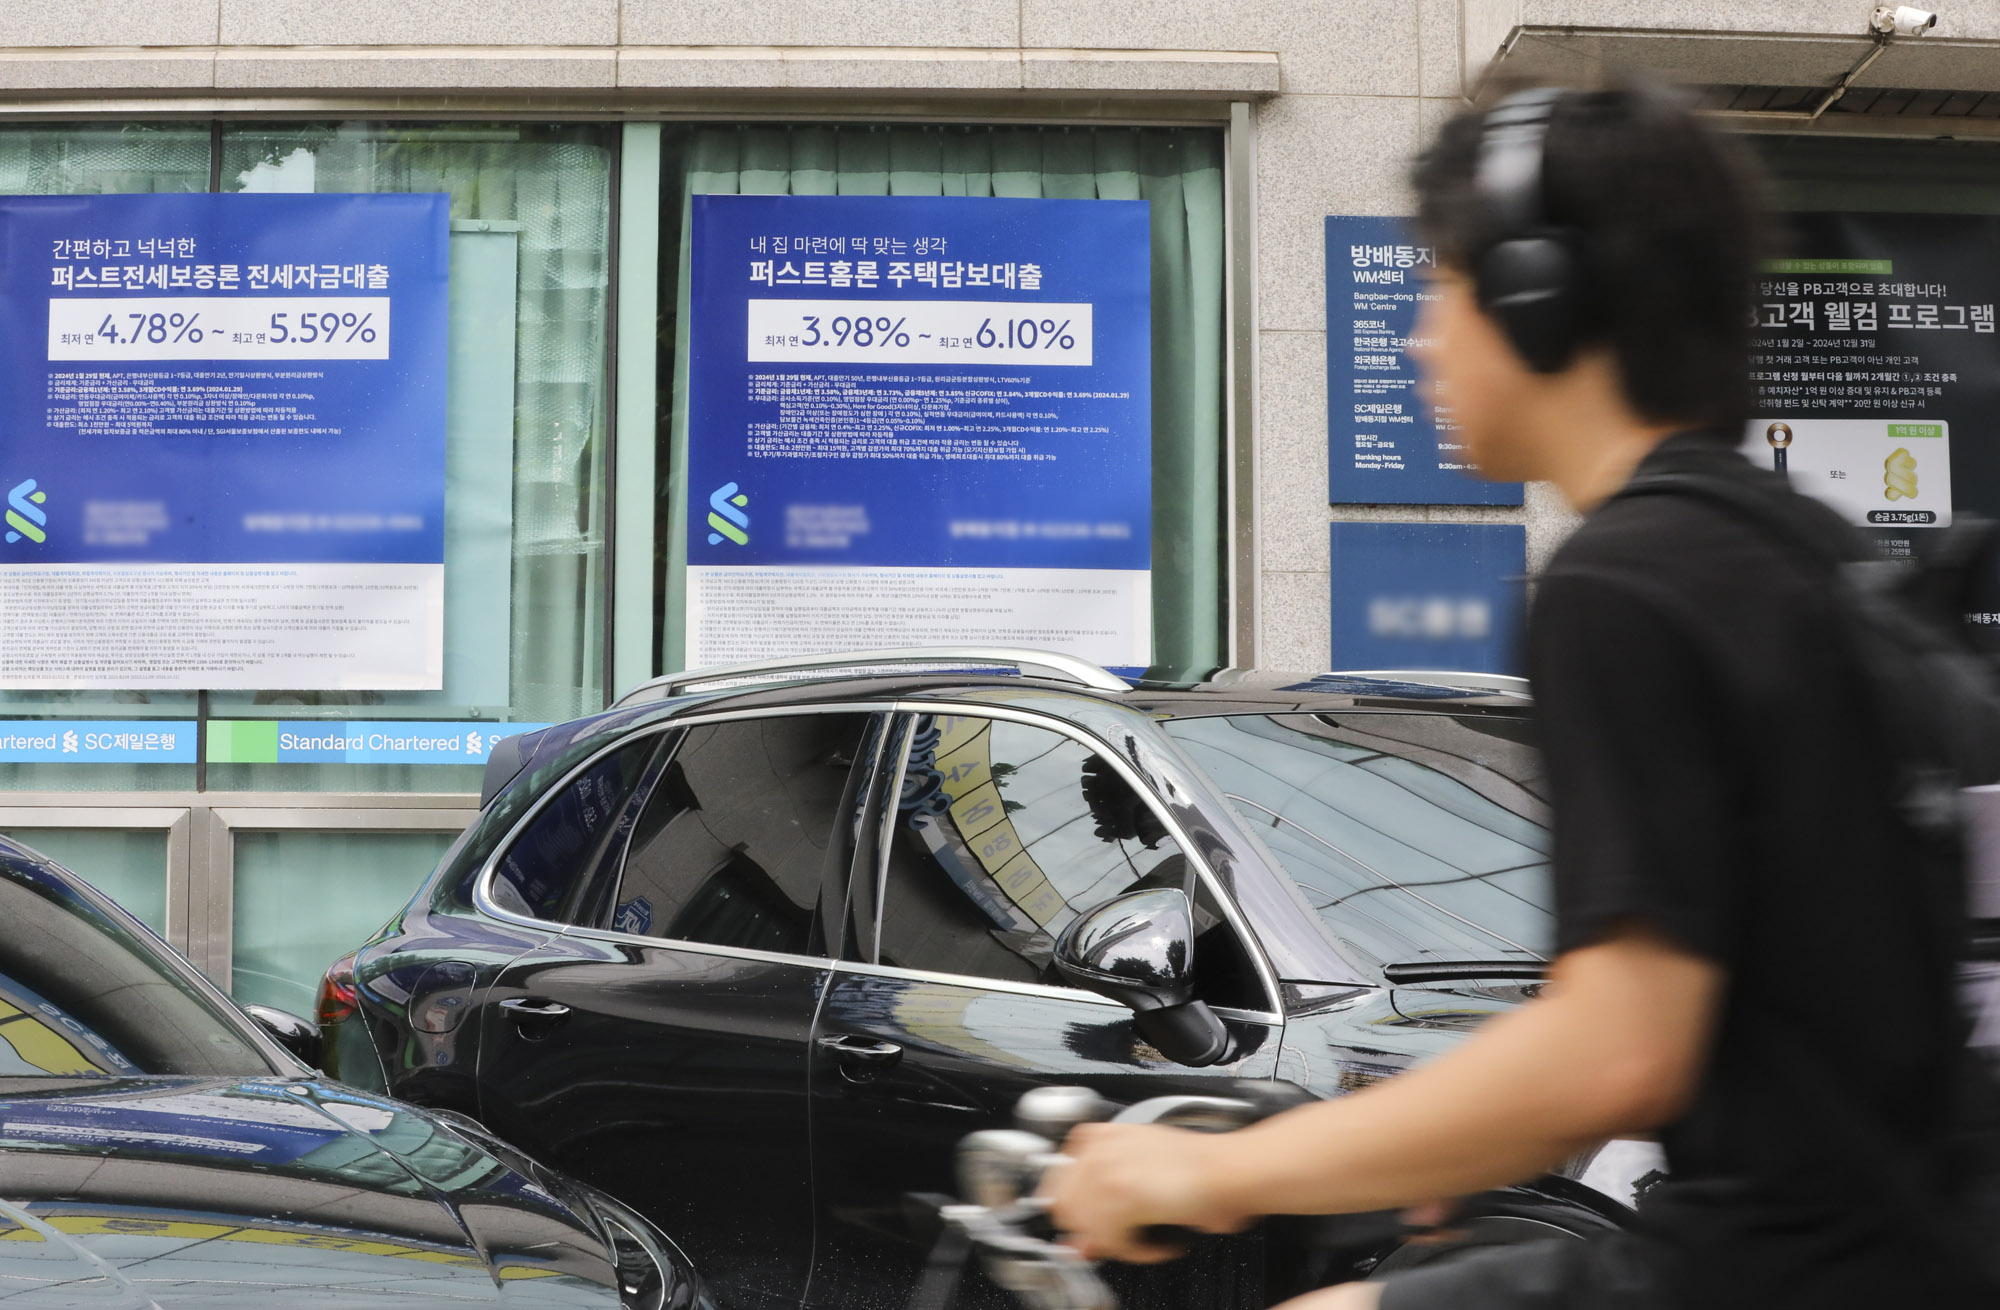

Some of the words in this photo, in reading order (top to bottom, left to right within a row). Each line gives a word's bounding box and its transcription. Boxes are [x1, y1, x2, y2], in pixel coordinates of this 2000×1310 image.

[53, 239, 131, 260] 간편하고
[138, 238, 197, 259] 넉넉한
[750, 237, 768, 255] 내
[773, 237, 789, 255] 집
[794, 237, 846, 255] 마련에
[852, 237, 868, 255] 딱
[874, 237, 907, 255] 맞는
[913, 237, 947, 255] 생각
[51, 265, 241, 291] 퍼스트전세보증론
[247, 264, 390, 290] 전세자금대출
[750, 261, 880, 288] 퍼스트홈론
[887, 262, 1043, 291] 주택담보대출
[1353, 270, 1404, 285] WM센터
[1804, 282, 1874, 296] PB고객으로
[1878, 283, 1947, 298] 초대합니다!
[1354, 292, 1413, 302] Bangbae-dong
[1354, 303, 1368, 311] WM
[1370, 303, 1397, 311] Centre
[1824, 301, 1878, 331] 웰컴
[1888, 303, 1995, 333] 프로그램
[60, 334, 82, 345] 최저
[84, 333, 95, 345] 연
[98, 313, 203, 345] 4.78%
[232, 333, 254, 344] 최고
[256, 333, 266, 344] 연
[269, 313, 376, 345] 5.59%
[1353, 320, 1386, 329] 365코너
[764, 335, 786, 348] 최저
[787, 334, 799, 348] 연
[802, 316, 911, 348] 3.98%
[939, 337, 960, 349] 최고
[962, 336, 973, 349] 연
[976, 318, 1075, 351] 6.10%
[1354, 337, 1388, 347] 한국은행
[1747, 339, 1775, 348] 024년
[1777, 339, 1789, 348] 1월
[1792, 339, 1804, 348] 2일
[1813, 339, 1841, 348] 2024년
[1843, 339, 1858, 348] 12월
[1860, 339, 1876, 348] 31일
[1354, 356, 1397, 366] 외국환은행
[1776, 356, 1792, 365] 거래
[1794, 356, 1810, 365] 고객
[1812, 356, 1828, 365] 또는
[1830, 356, 1865, 365] PB고객이
[1867, 356, 1883, 365] 아닌
[1885, 356, 1901, 365] 개인
[1904, 356, 1919, 365] 고객
[1783, 372, 1799, 381] 신청
[1827, 372, 1843, 381] 다음
[1924, 373, 1940, 382] 조건
[1829, 387, 1844, 395] 이상
[1891, 387, 1897, 395] &
[1899, 387, 1925, 395] PB고객
[1784, 399, 1800, 408] 펀드
[1883, 399, 1898, 408] 이상
[1918, 399, 1925, 408] 시
[1354, 404, 1402, 414] SC제일은행
[1354, 416, 1387, 424] 방배동지점
[1389, 416, 1413, 424] WM센터
[1896, 427, 1907, 436] 1억
[1919, 427, 1935, 436] 이상
[1830, 470, 1847, 479] 또는
[1875, 514, 1890, 522] 순금
[85, 734, 176, 751] SC제일은행
[280, 733, 363, 751] Standard
[369, 734, 460, 751] Chartered
